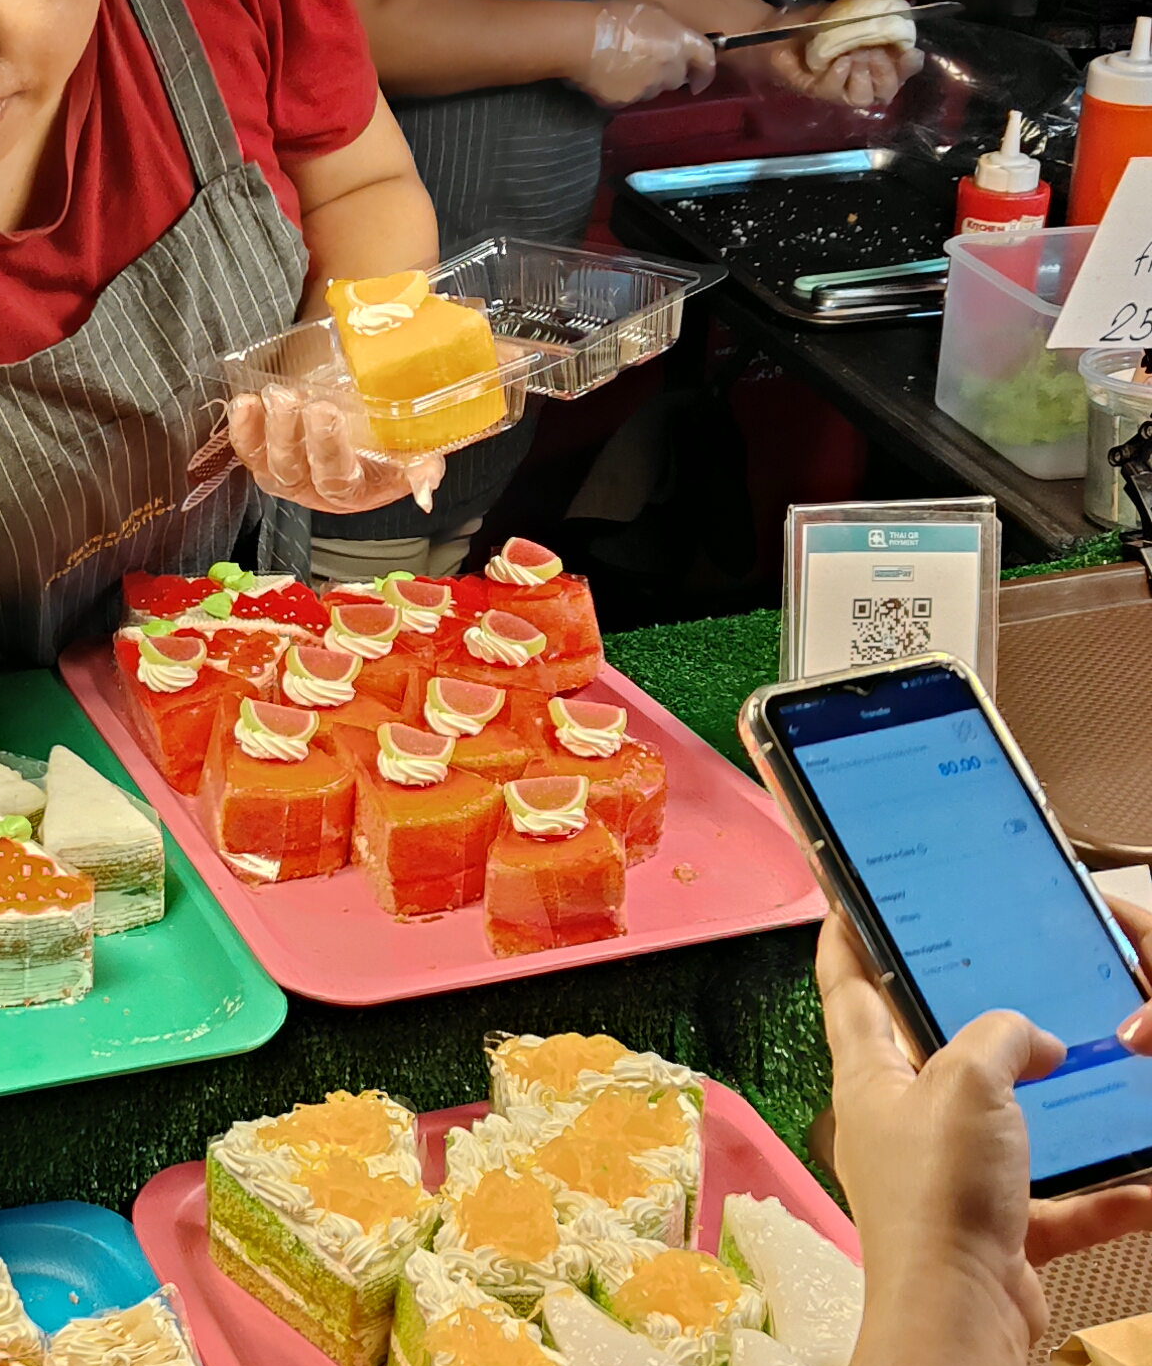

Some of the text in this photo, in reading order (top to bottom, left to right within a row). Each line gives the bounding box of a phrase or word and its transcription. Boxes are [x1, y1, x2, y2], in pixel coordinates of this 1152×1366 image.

[889, 531, 920, 539] THAI QR
[889, 539, 920, 547] PAYMENT
